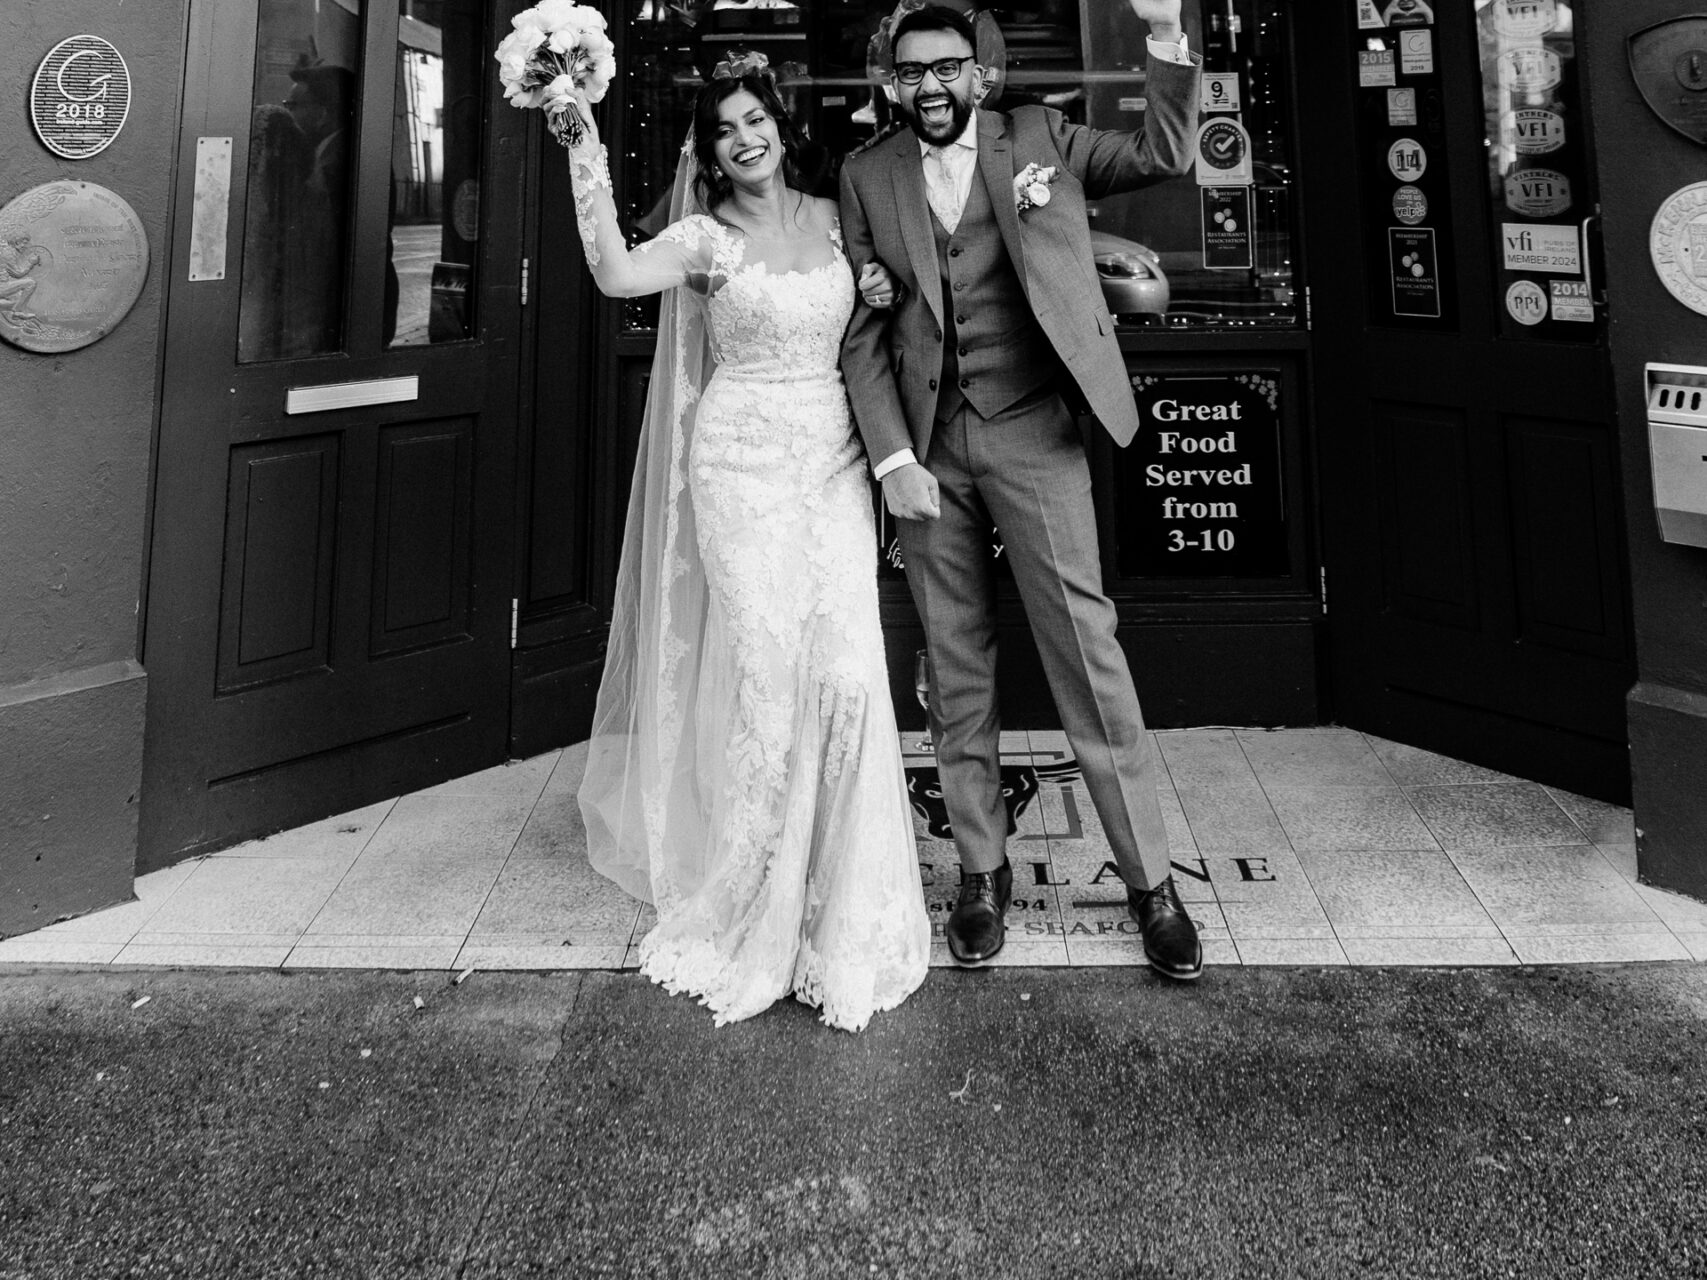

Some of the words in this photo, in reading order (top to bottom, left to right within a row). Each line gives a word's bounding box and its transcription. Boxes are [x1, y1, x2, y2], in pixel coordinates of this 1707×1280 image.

[1361, 52, 1391, 65] 2015
[56, 103, 105, 119] 2018
[1516, 122, 1547, 136] VFI
[1521, 183, 1553, 197] VFI
[1396, 206, 1415, 217] yelp
[1506, 230, 1532, 251] vfi
[1507, 254, 1549, 264] MEMBER
[1551, 256, 1577, 266] 2024
[1552, 282, 1588, 296] 2014
[1151, 399, 1242, 421] Great
[1158, 431, 1237, 454] Food
[1145, 463, 1253, 486] Served
[1162, 496, 1239, 519] from
[1167, 529, 1235, 552] 3-10
